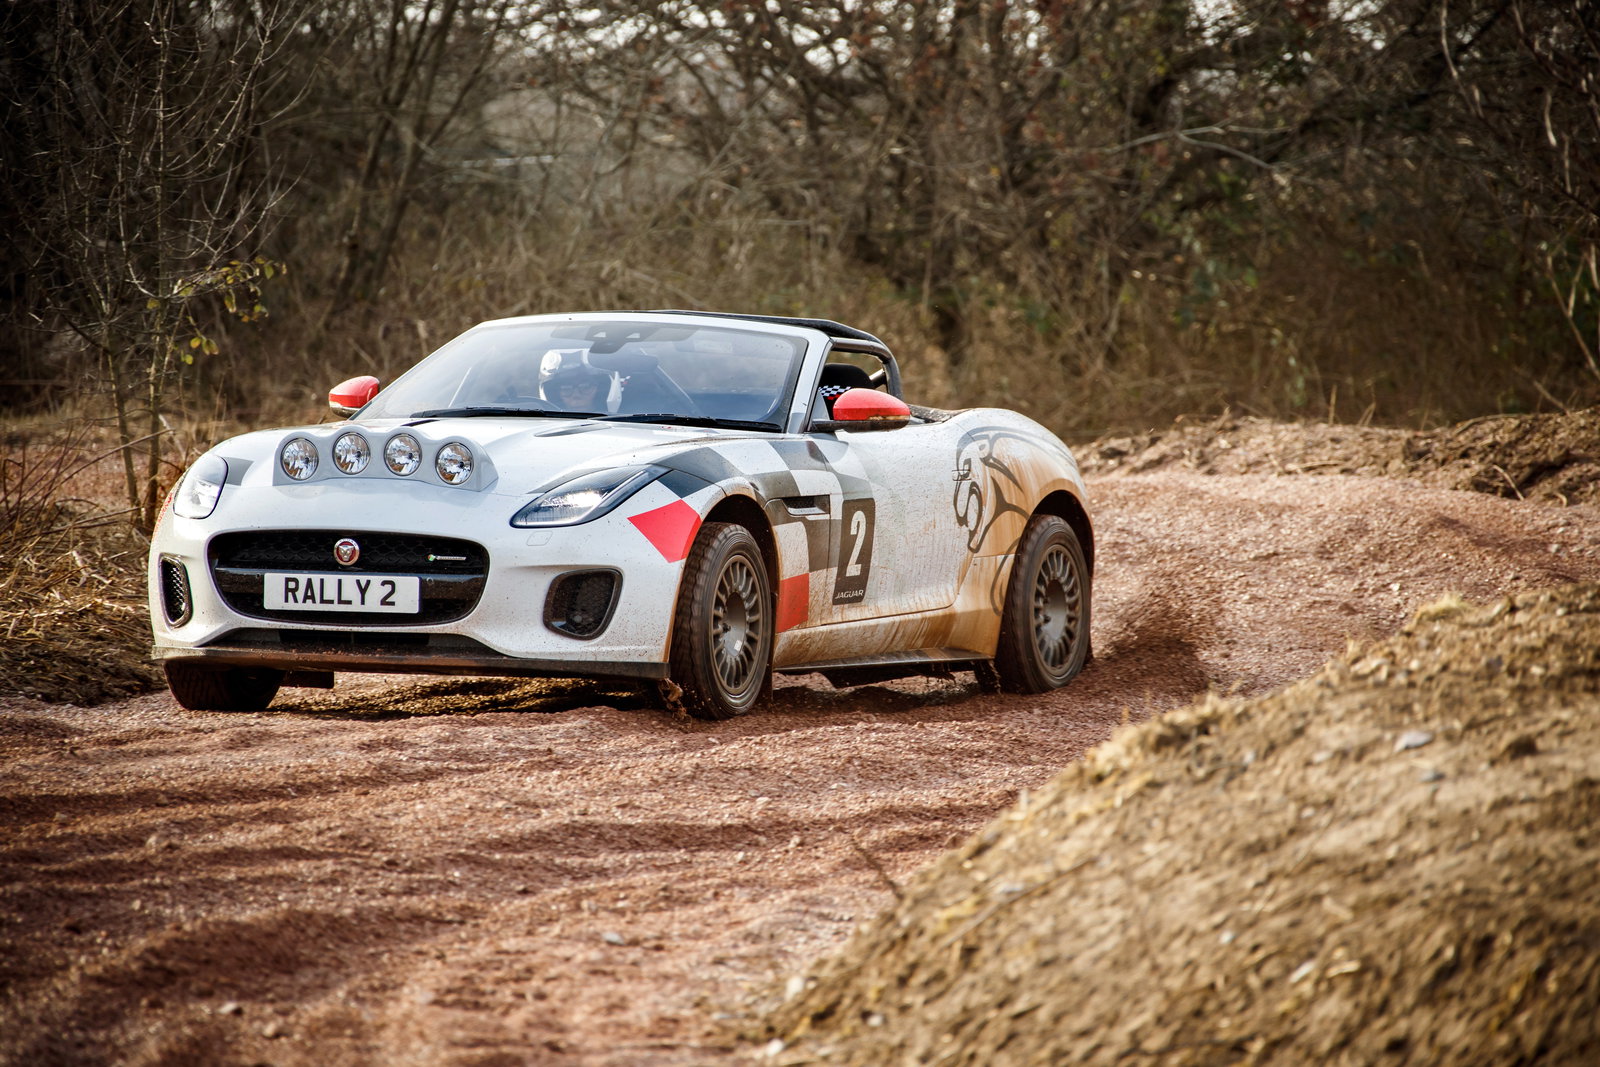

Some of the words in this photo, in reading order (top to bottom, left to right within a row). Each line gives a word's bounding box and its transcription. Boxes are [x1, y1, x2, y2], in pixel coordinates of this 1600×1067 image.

[846, 510, 866, 576] 2
[284, 576, 371, 606] RALLY
[380, 579, 396, 606] 2
[835, 589, 864, 599] JAGUAR
